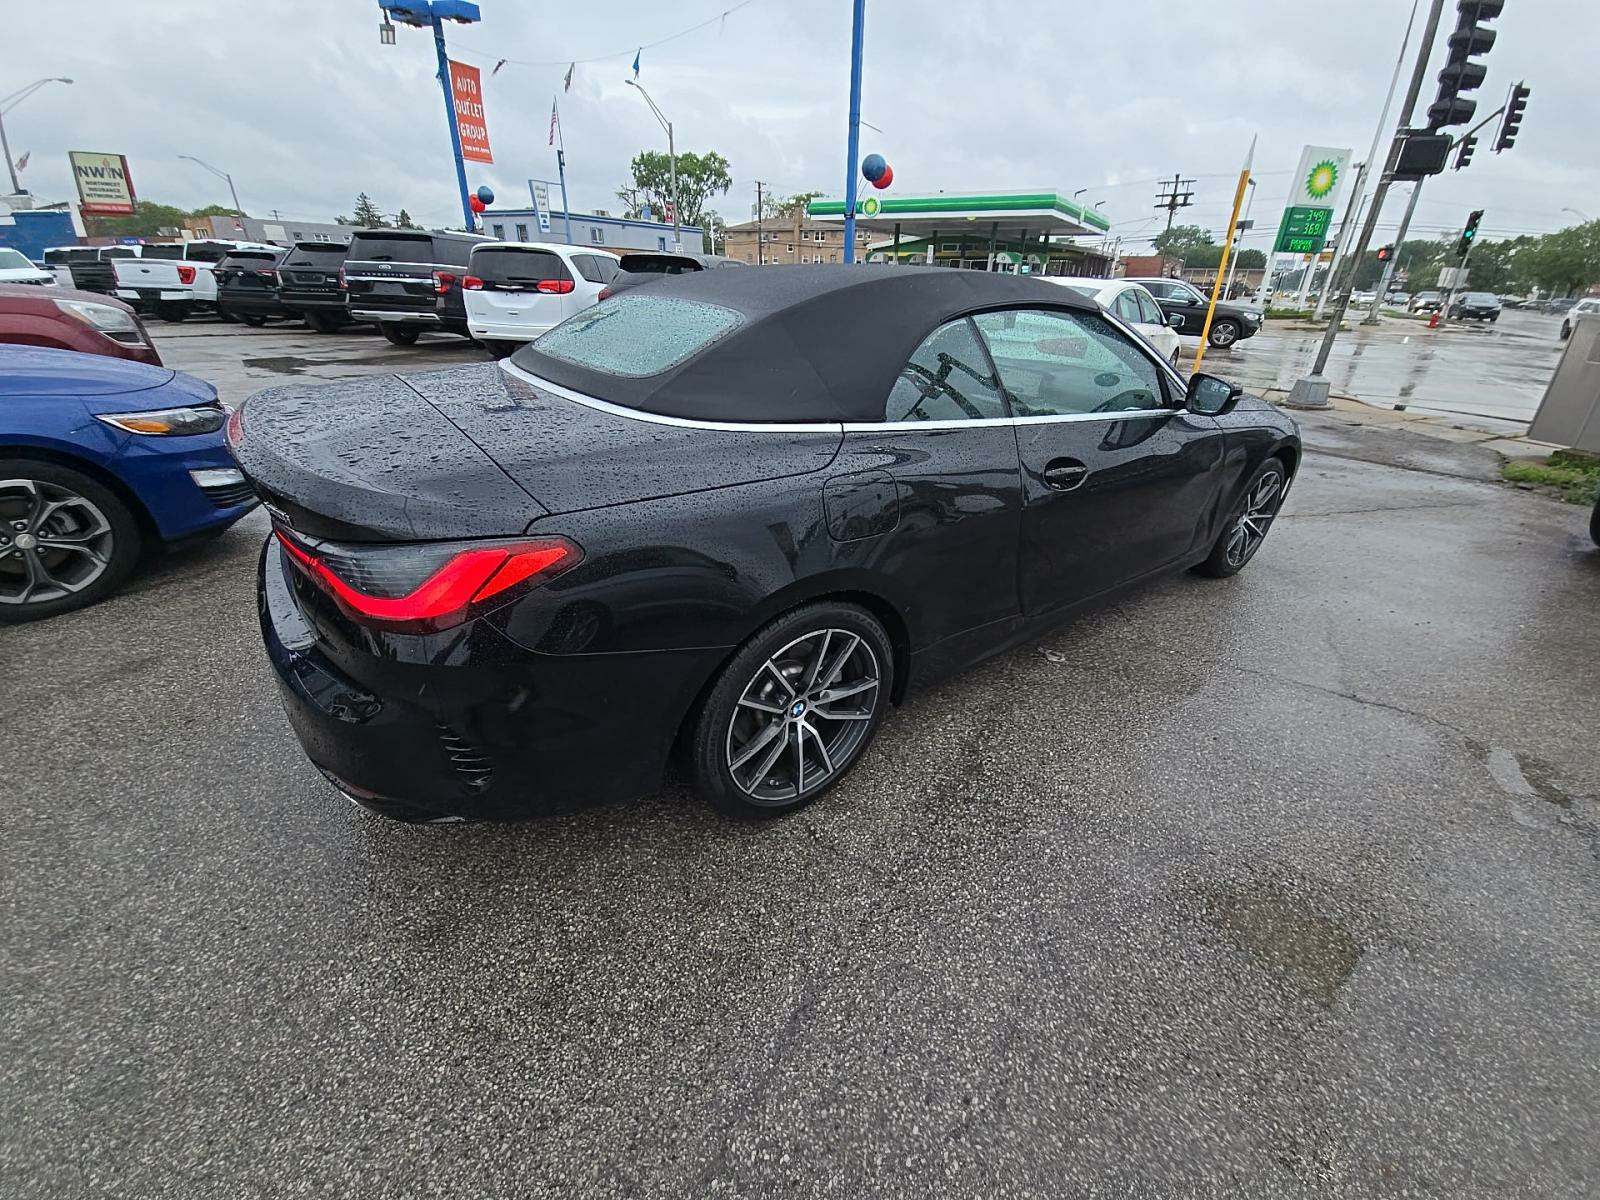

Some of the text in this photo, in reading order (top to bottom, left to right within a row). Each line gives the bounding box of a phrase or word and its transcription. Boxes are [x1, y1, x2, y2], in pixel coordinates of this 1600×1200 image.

[456, 76, 477, 95] AUTO
[456, 99, 483, 119] OUTLET
[460, 122, 486, 141] GROUP
